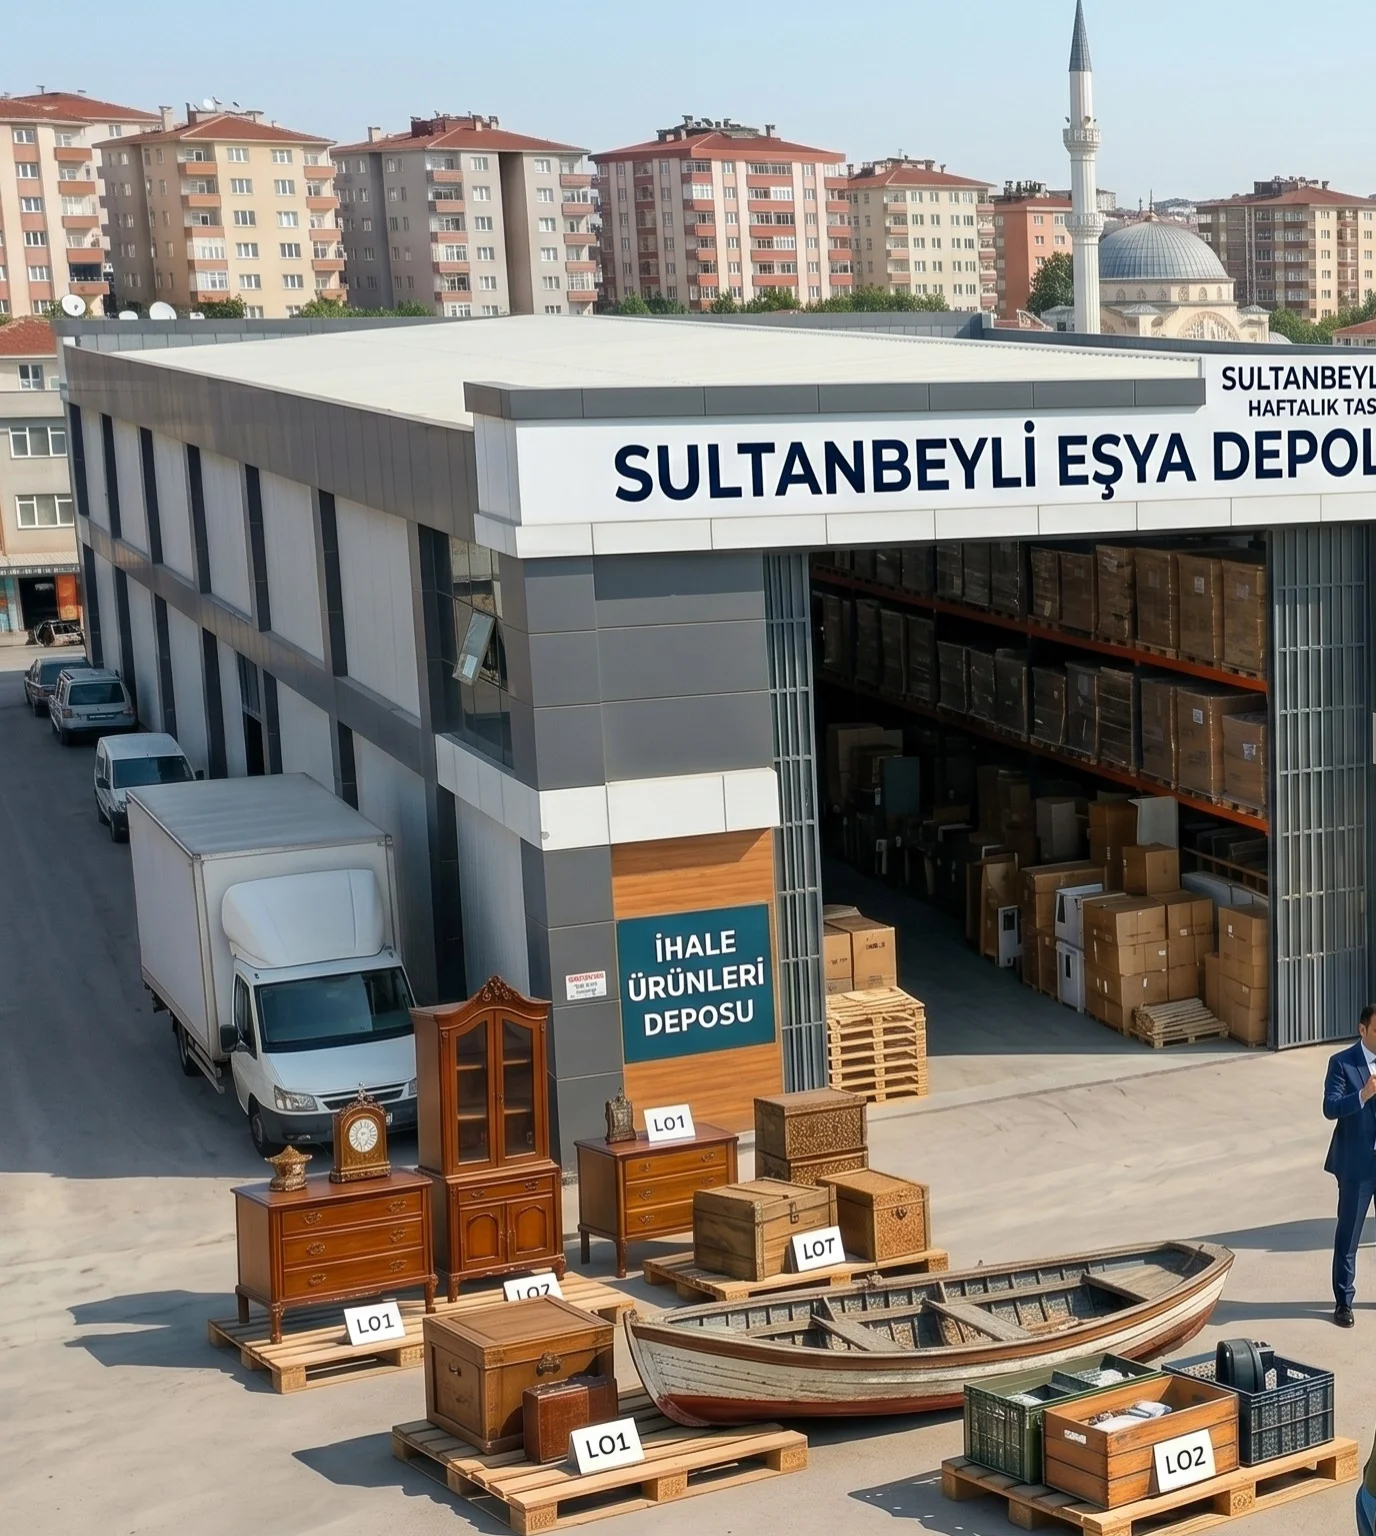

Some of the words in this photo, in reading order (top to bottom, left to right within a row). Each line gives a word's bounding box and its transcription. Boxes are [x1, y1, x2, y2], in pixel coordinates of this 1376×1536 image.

[1248, 398, 1339, 417] HAFTALIK
[614, 420, 1036, 501] SULTANBEYLİ
[1058, 432, 1196, 500] EŞYA
[655, 929, 736, 963] İHALE
[628, 956, 765, 1001] ÜRÜNLERİ
[643, 999, 754, 1036] DEPOSU
[802, 1235, 836, 1260] LOT
